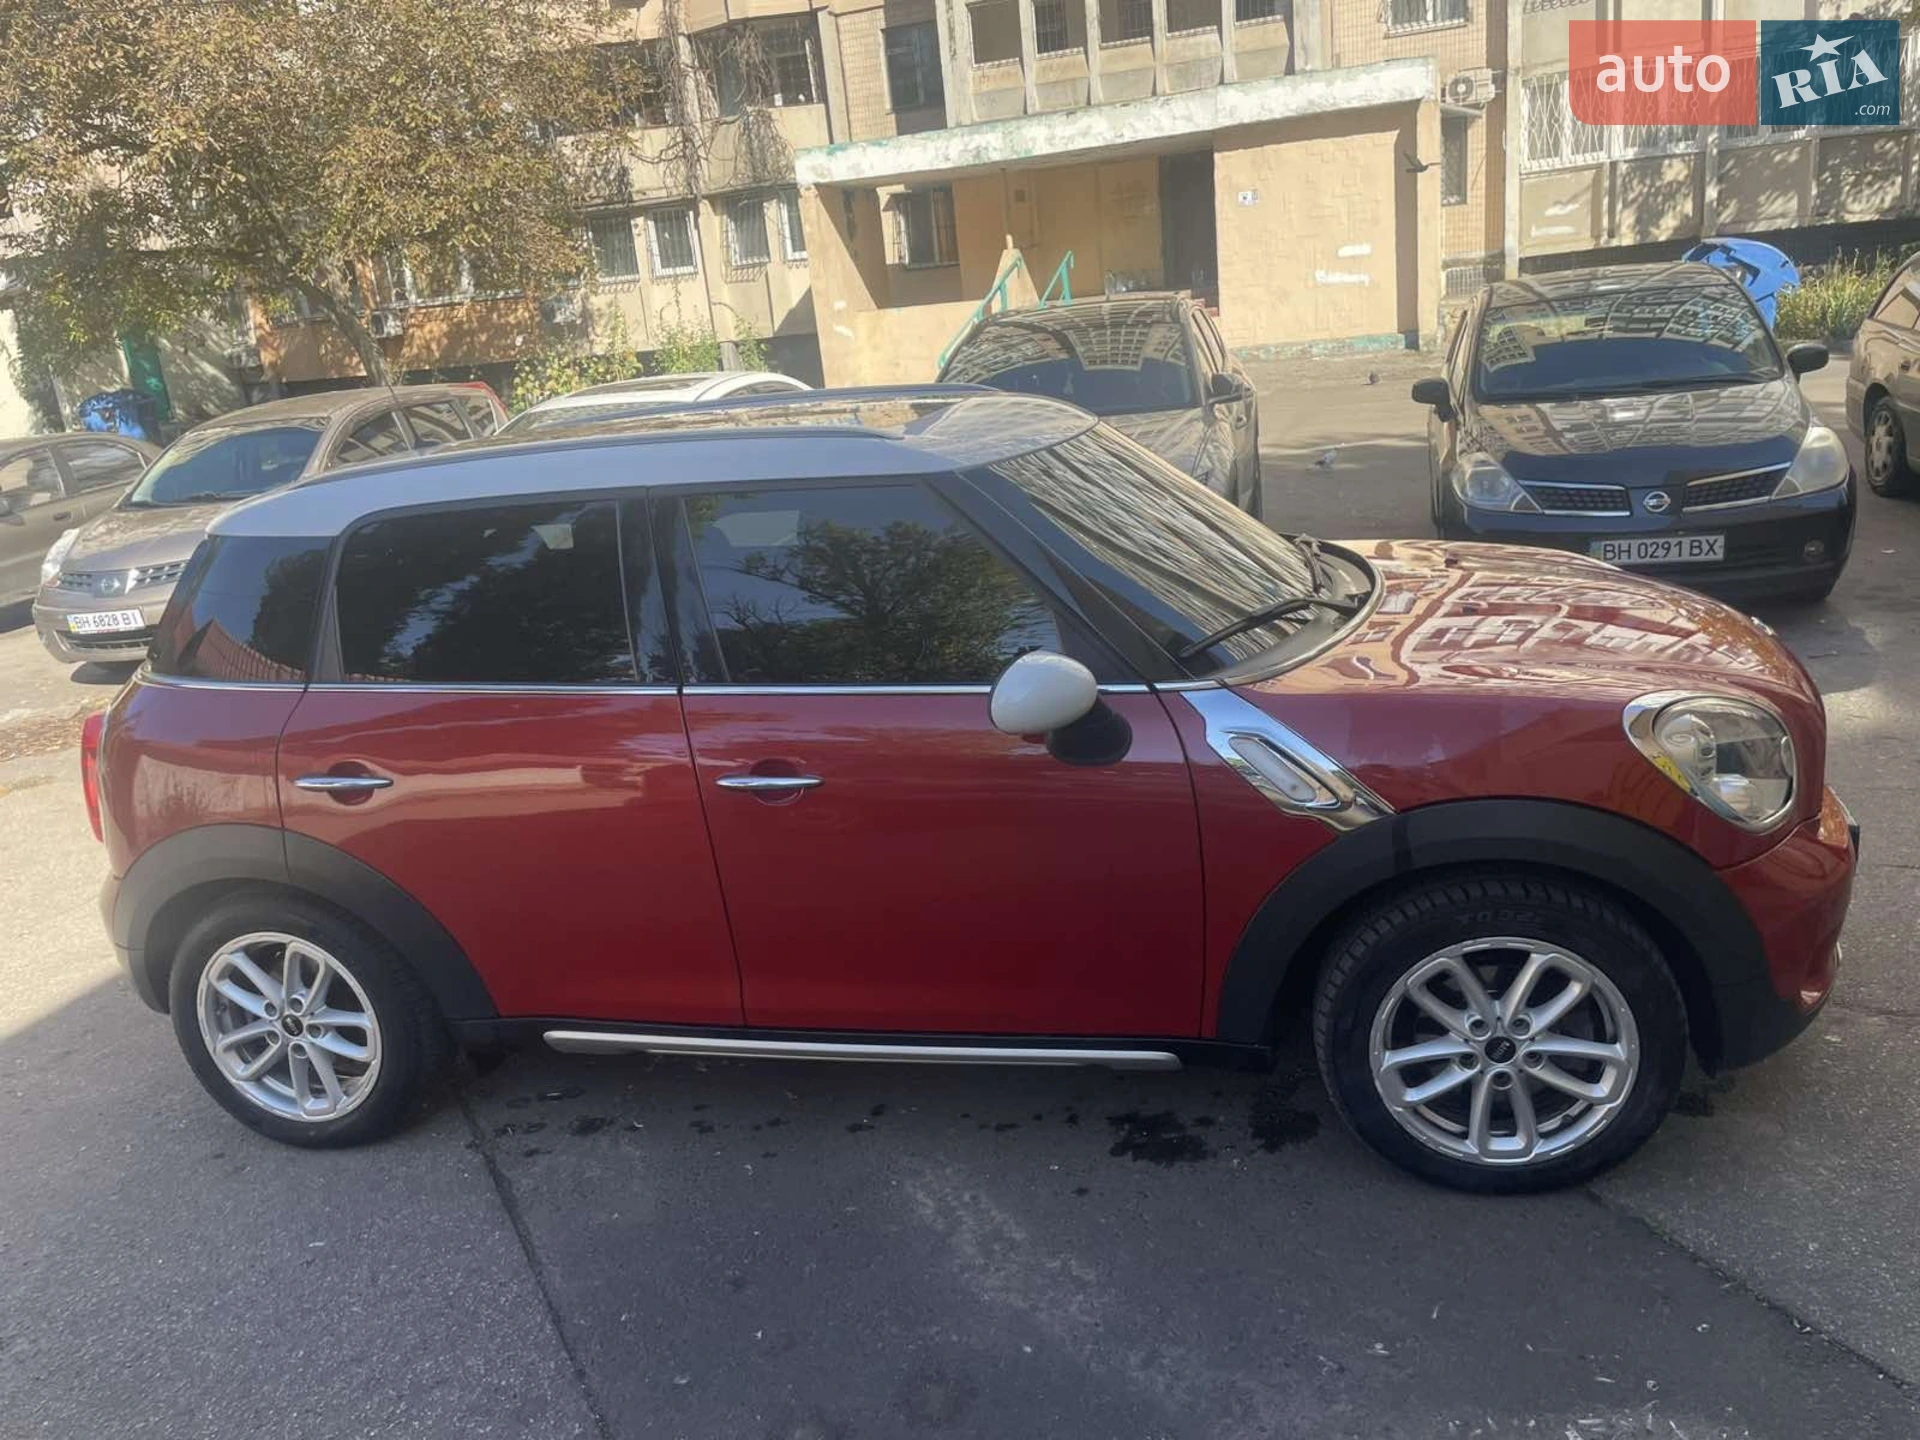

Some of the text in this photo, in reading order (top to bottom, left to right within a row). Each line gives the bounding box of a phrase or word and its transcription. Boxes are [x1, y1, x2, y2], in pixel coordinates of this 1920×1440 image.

[1602, 538, 1718, 561] BH 0291 BX
